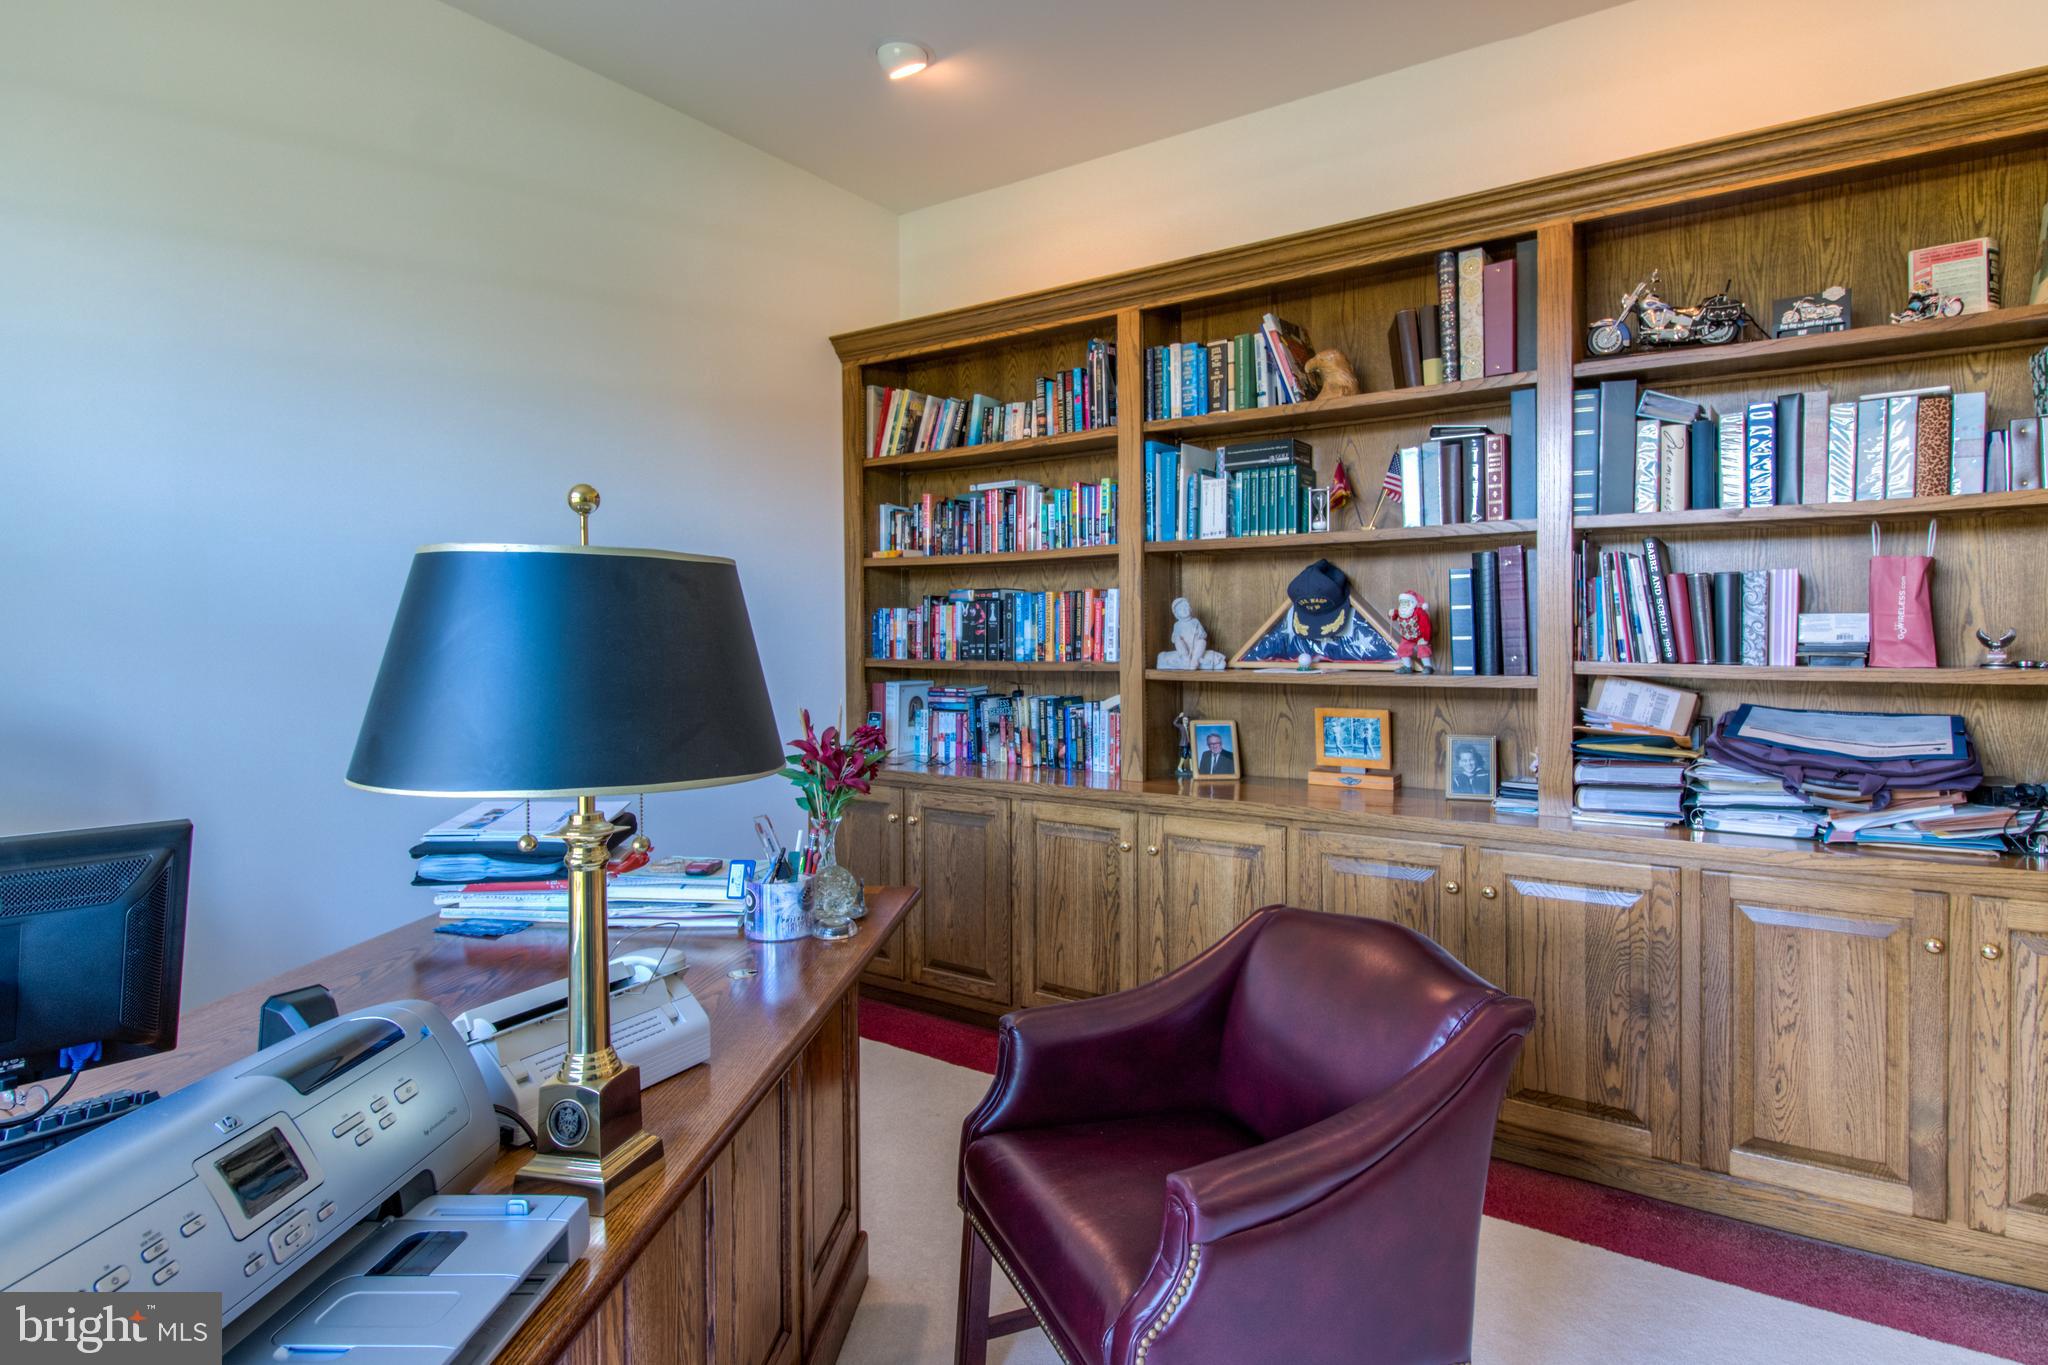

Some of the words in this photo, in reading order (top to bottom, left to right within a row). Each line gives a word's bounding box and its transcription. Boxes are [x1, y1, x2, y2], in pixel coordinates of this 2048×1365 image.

[1663, 430, 1685, 513] Memories
[1646, 542, 1658, 572] SABRE
[1652, 575, 1662, 596] AND
[1656, 598, 1668, 635] SCROLL
